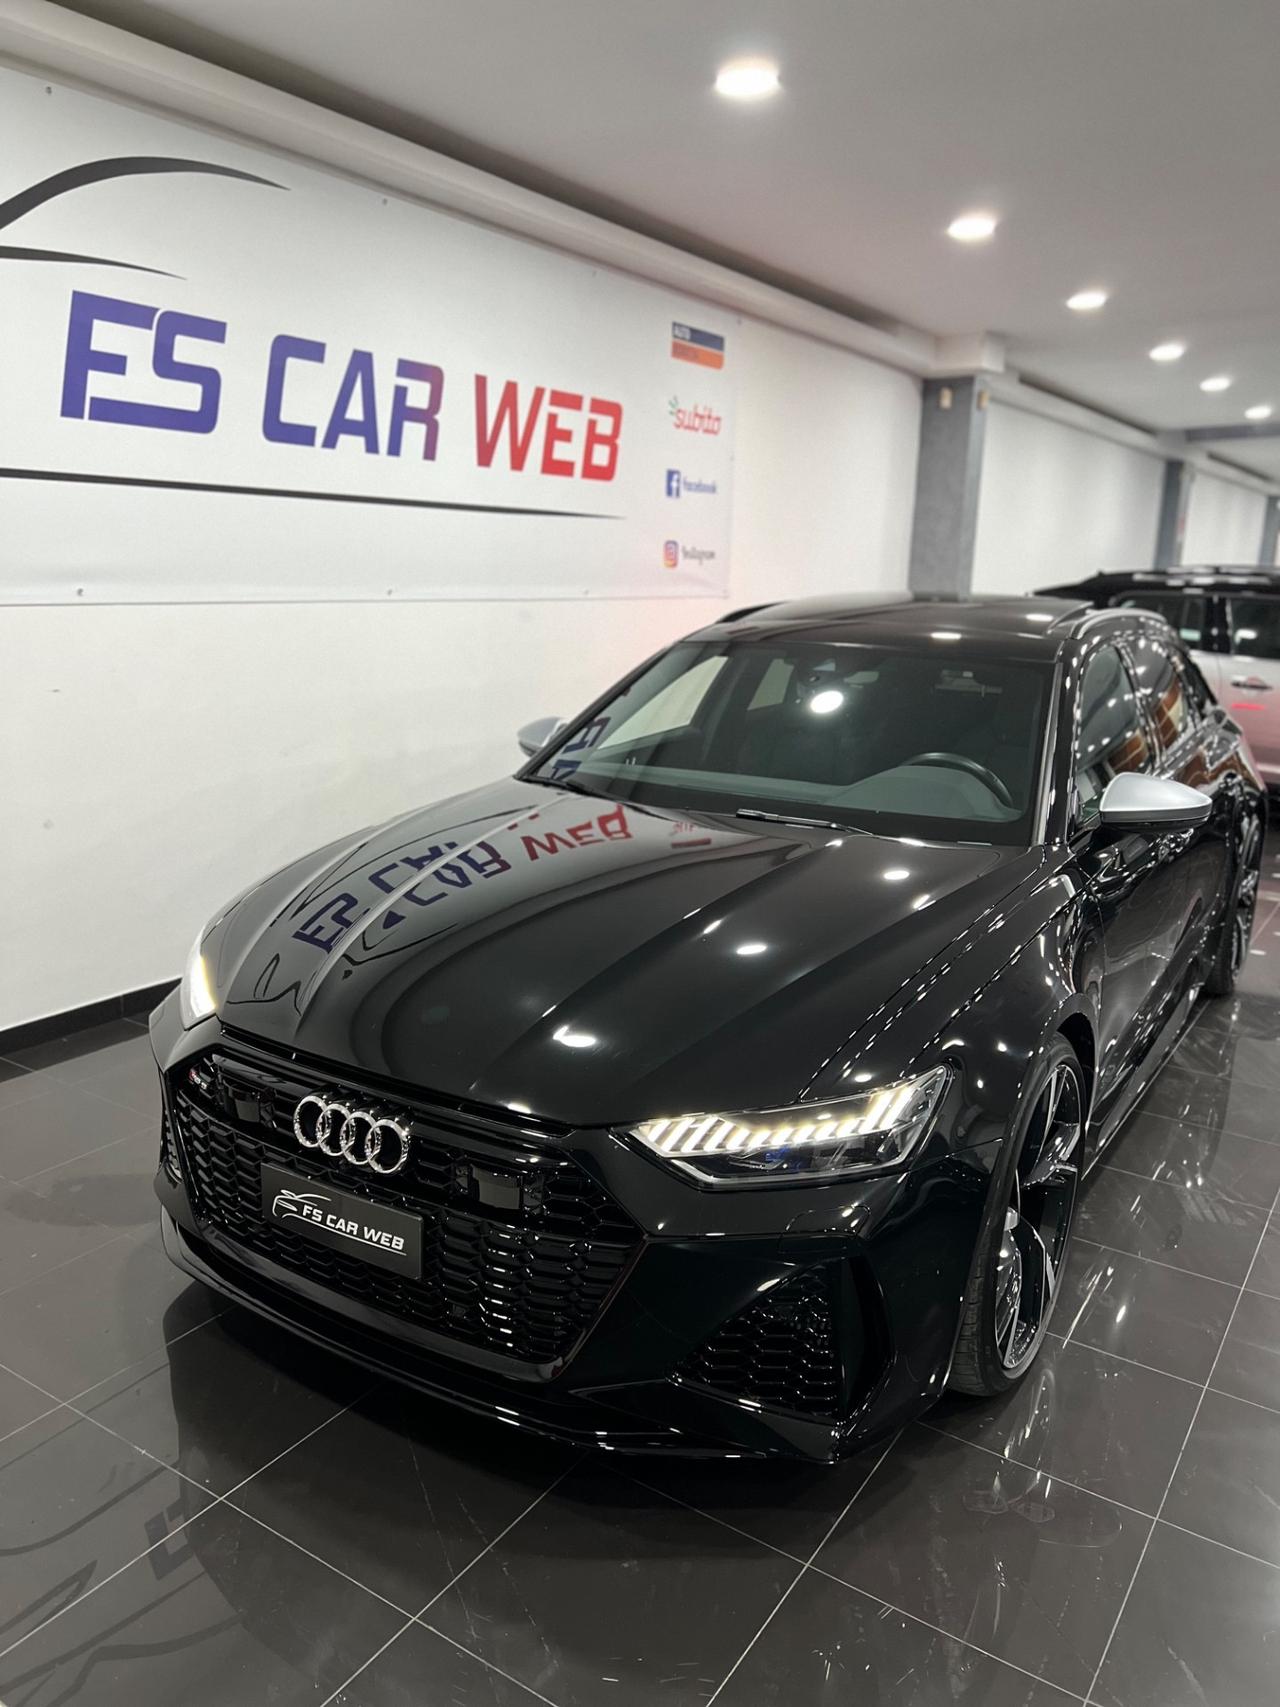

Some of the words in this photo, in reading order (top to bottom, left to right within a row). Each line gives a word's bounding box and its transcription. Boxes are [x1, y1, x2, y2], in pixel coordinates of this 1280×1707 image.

[262, 333, 445, 462] CAR
[474, 373, 625, 483] WEB
[302, 1204, 323, 1222] FS
[326, 1214, 359, 1236] CAR
[363, 1226, 405, 1251] WEB
